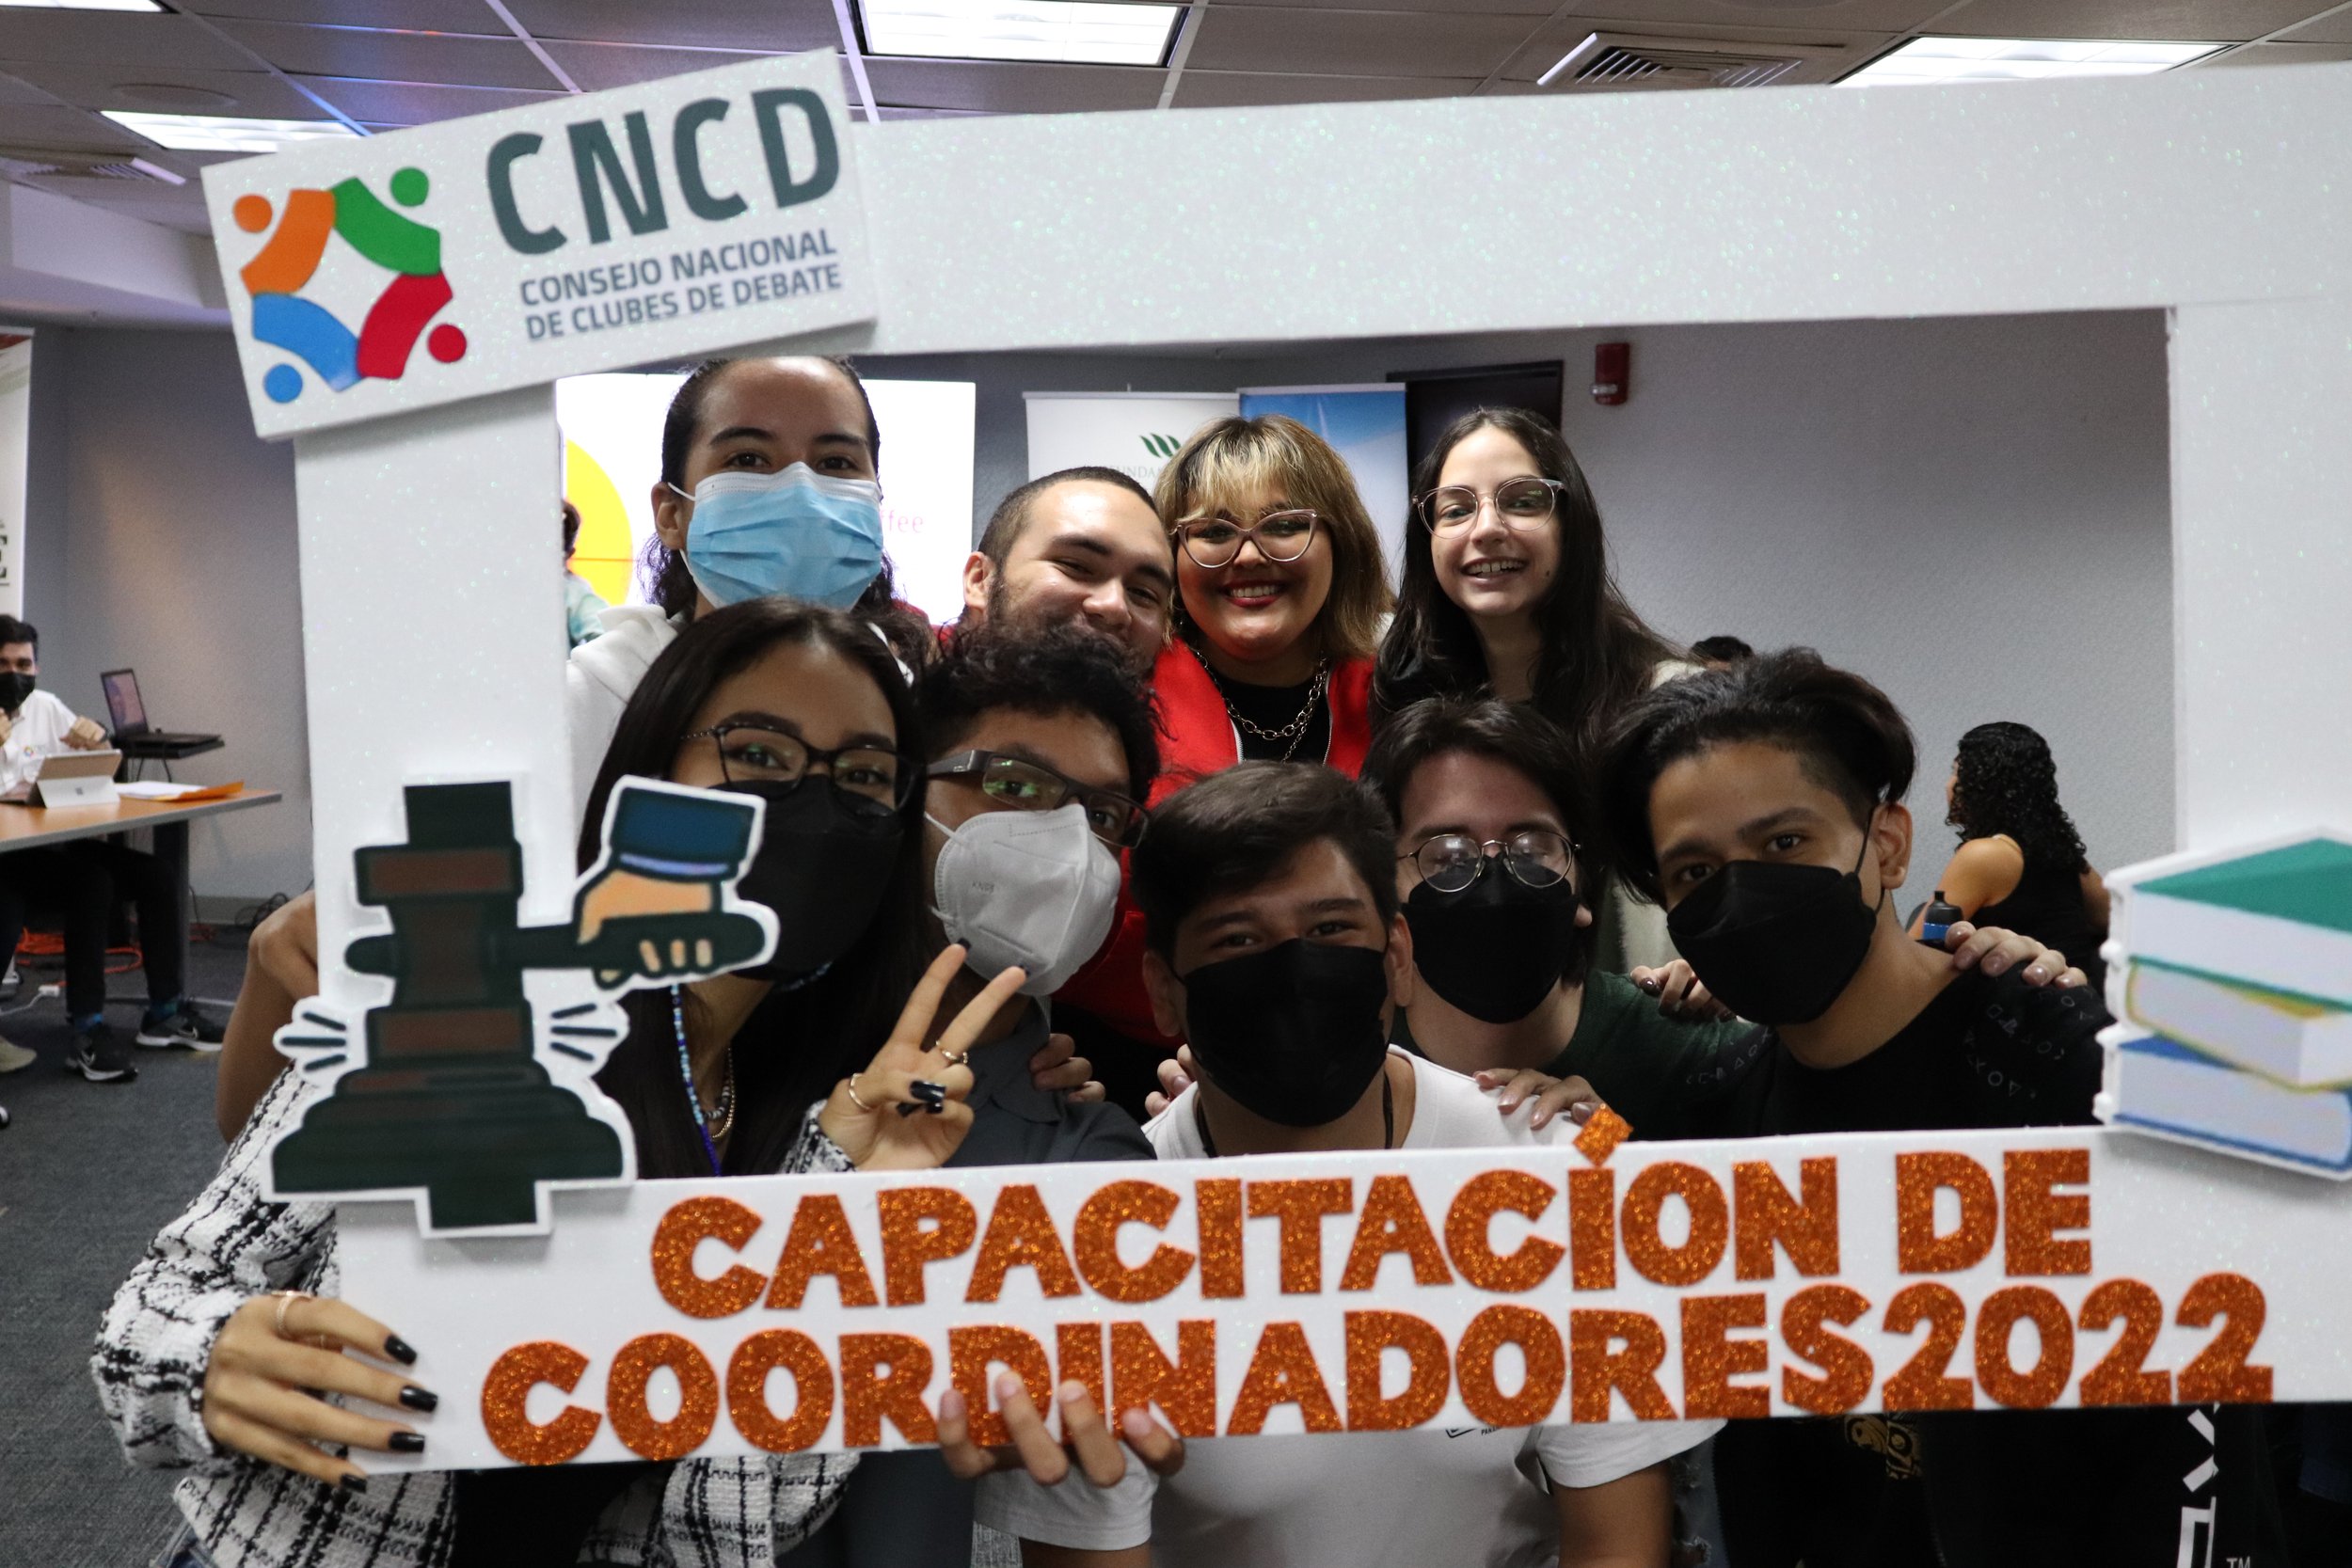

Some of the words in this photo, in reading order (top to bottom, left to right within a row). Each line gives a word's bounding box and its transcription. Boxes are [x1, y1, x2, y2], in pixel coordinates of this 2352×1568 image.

[485, 87, 840, 255] CNCD
[520, 259, 663, 307] CONSEJO
[671, 230, 836, 282] NACIONAL
[526, 311, 564, 341] DE
[572, 293, 679, 333] CLUBES
[688, 285, 723, 314] DE
[733, 264, 841, 307] DEBATE
[1895, 1149, 2092, 1276] DE
[481, 1273, 2274, 1467] COORDINADORES2022
